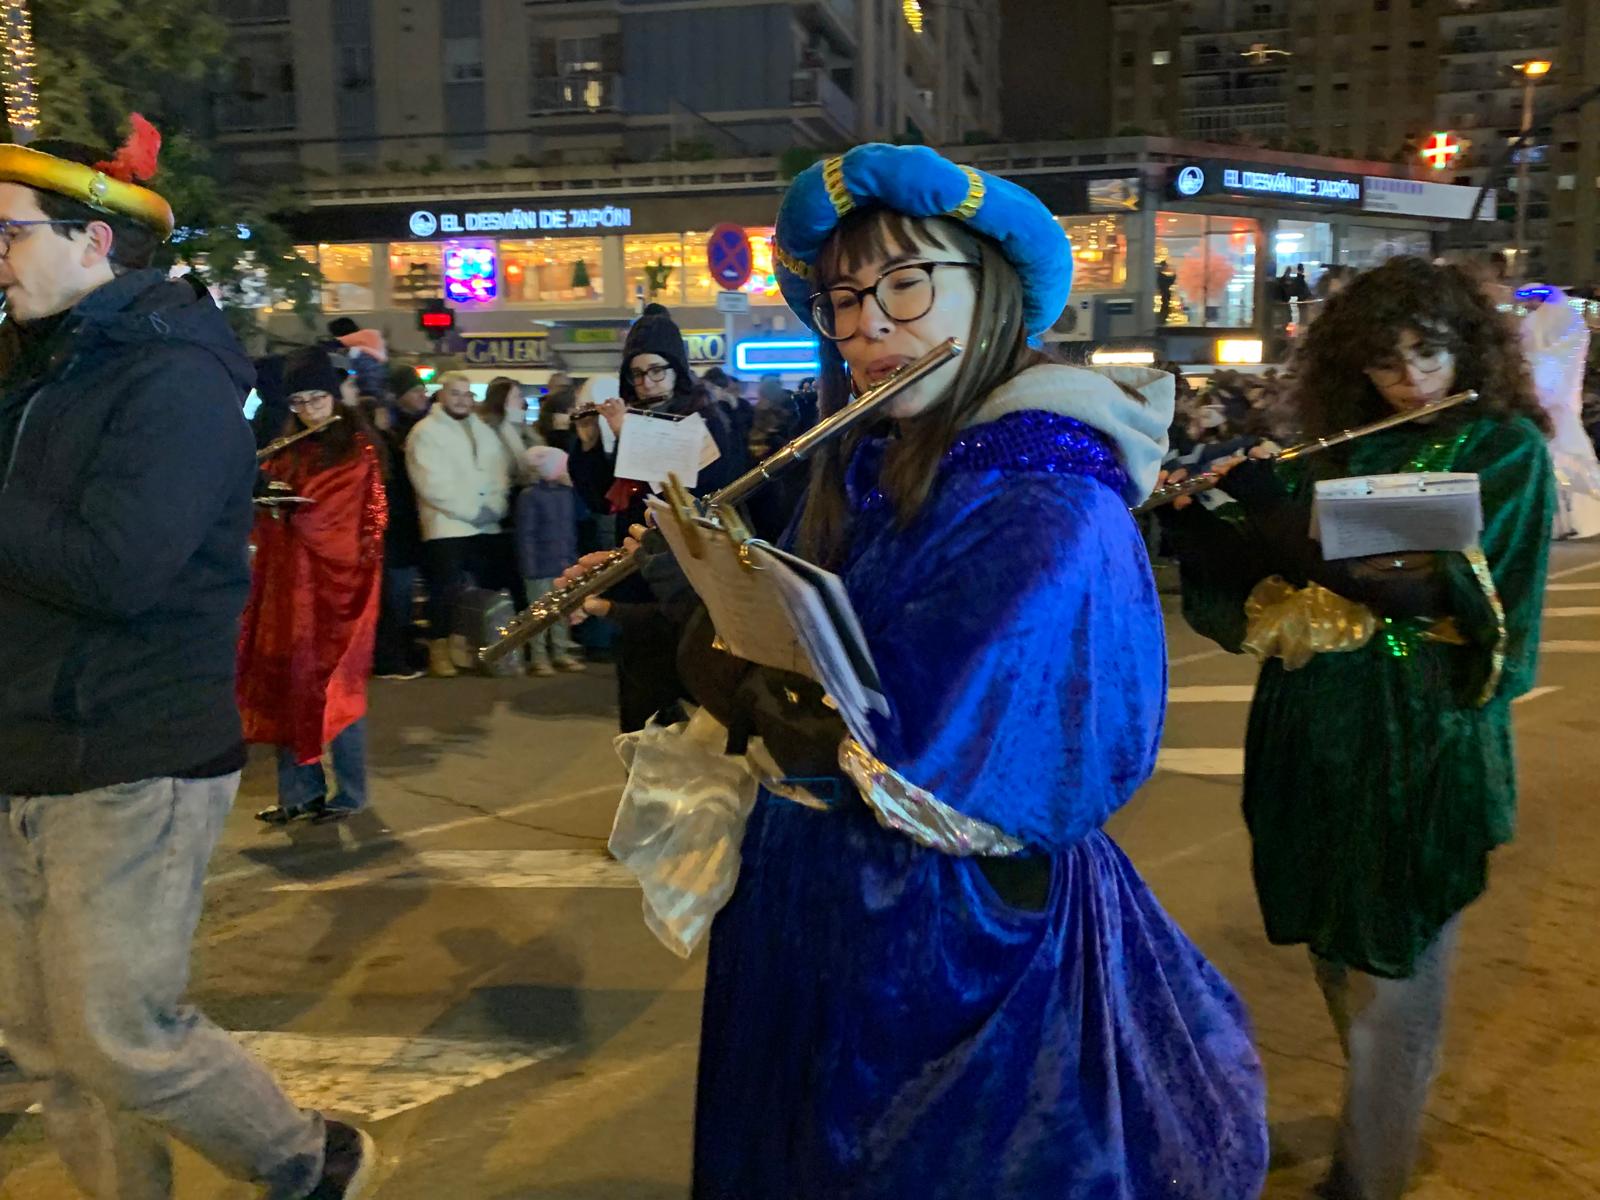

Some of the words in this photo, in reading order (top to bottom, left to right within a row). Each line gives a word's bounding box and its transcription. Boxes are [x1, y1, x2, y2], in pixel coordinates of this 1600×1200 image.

[1223, 169, 1242, 188] EL
[1295, 177, 1316, 195] DE
[1316, 179, 1360, 200] JAPÓN
[440, 214, 464, 232] EL
[464, 208, 537, 231] DESVÁN
[539, 209, 567, 229] DE
[567, 205, 632, 228] JAPÓN
